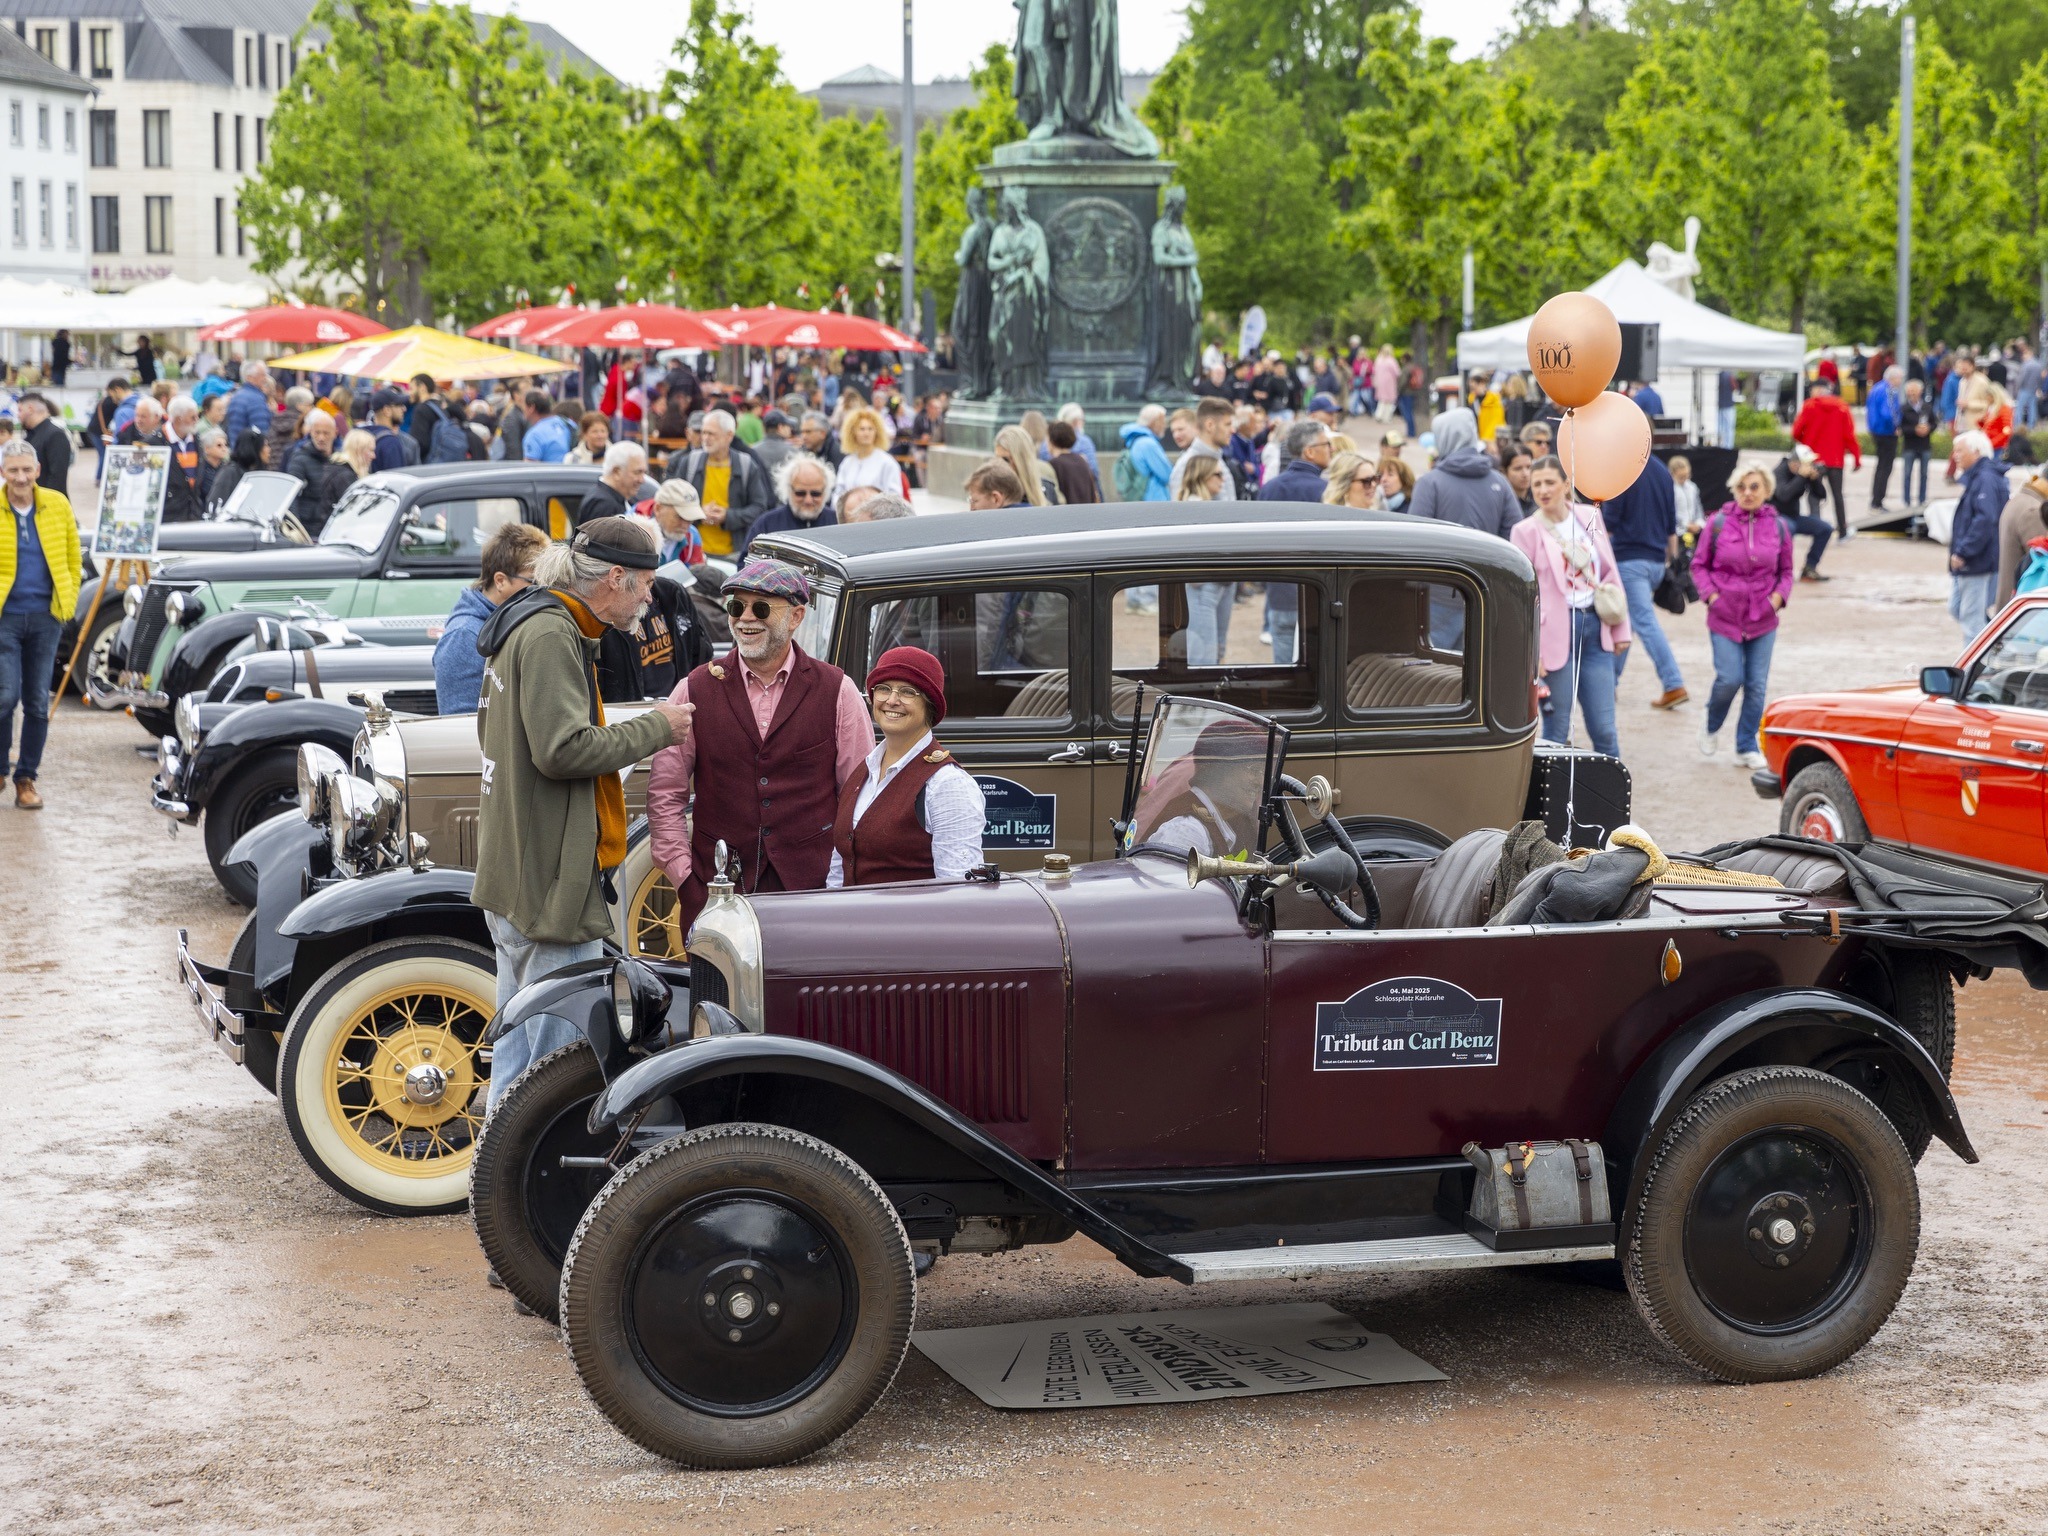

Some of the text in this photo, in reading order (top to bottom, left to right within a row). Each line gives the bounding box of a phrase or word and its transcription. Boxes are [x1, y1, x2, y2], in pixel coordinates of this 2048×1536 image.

[1538, 348, 1571, 369] 100
[982, 820, 1051, 835] Carl Benz
[1375, 995, 1414, 1003] Schlossplatz
[1320, 1031, 1494, 1052] Tribut an Carl Benz
[838, 1261, 884, 1393] MICHELIN
[1117, 1325, 1250, 1391] EINDRUCK
[1156, 1323, 1326, 1385] KEINE FLECKEN
[1043, 1331, 1081, 1402] ECHTE LEGENDEN
[1083, 1329, 1161, 1398] HINTERLASSEN
